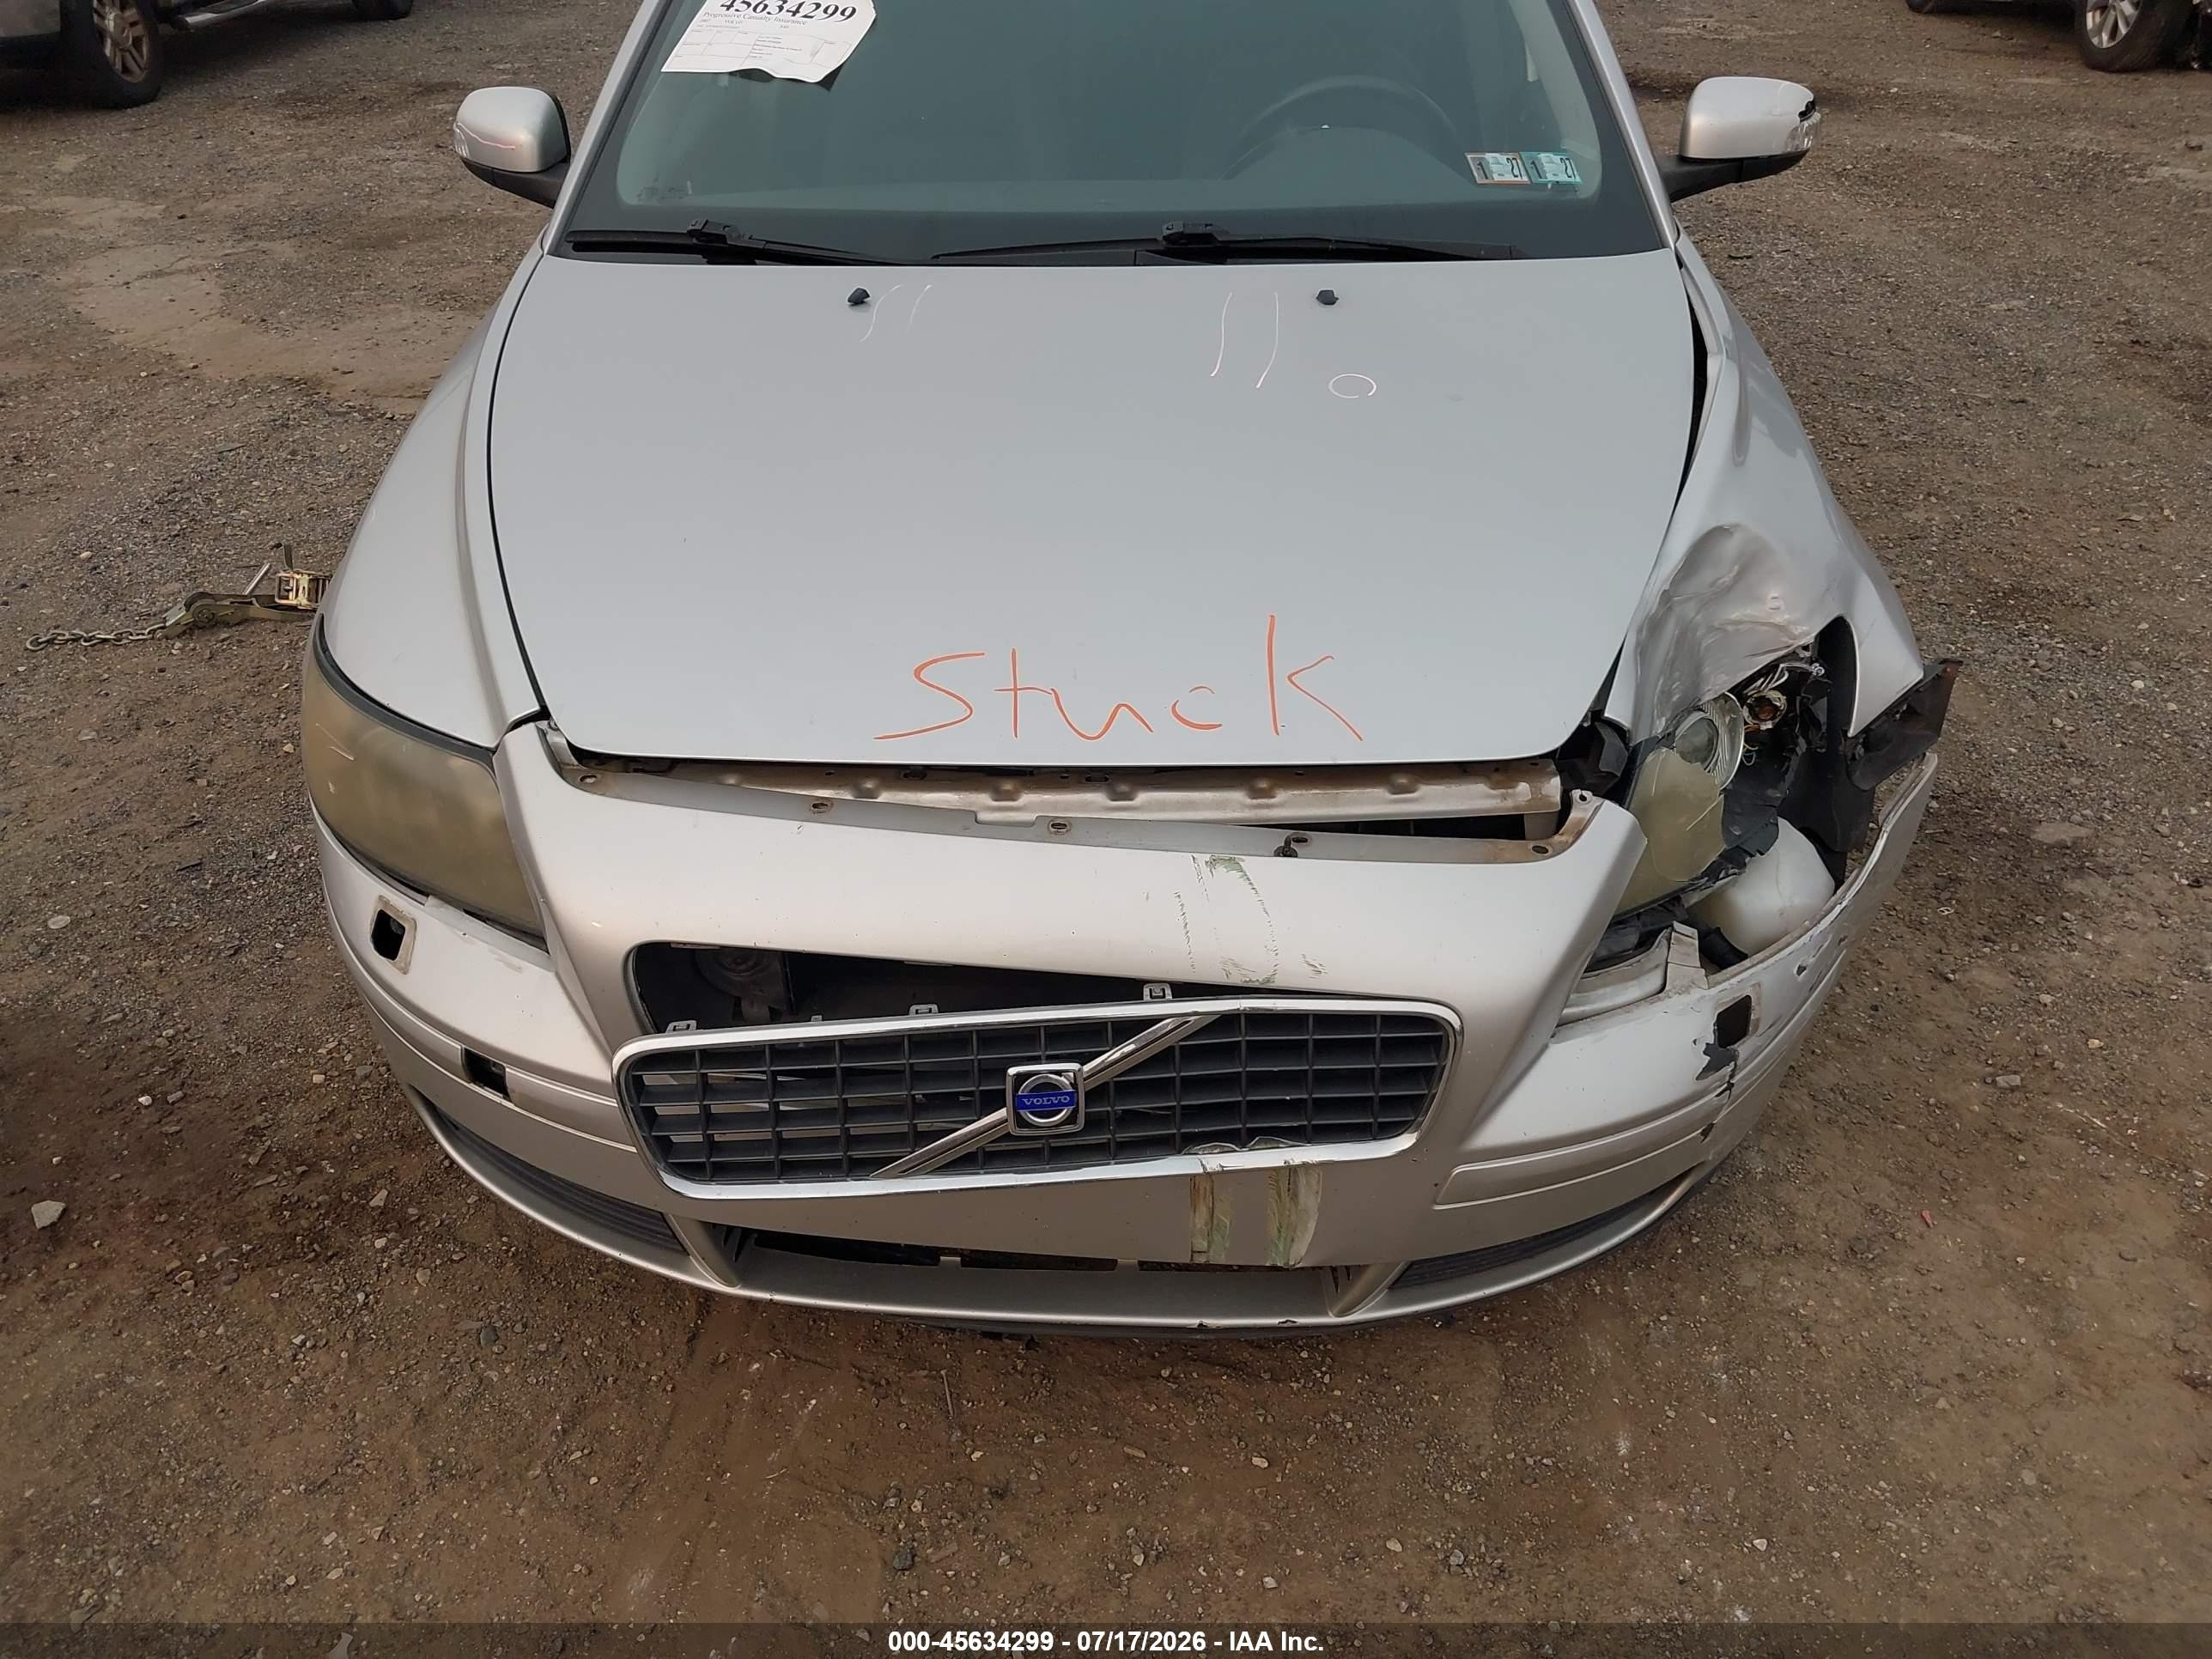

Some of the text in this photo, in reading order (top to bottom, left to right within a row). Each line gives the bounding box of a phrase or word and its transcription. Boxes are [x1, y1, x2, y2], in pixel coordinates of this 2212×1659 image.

[720, 0, 857, 22] 45634299
[742, 13, 771, 21] Casualty
[773, 15, 808, 26] Insurance
[1505, 157, 1523, 179] 27
[1559, 157, 1577, 179] 27
[873, 613, 1364, 743] Stuck
[1022, 1096, 1070, 1105] VOLVO
